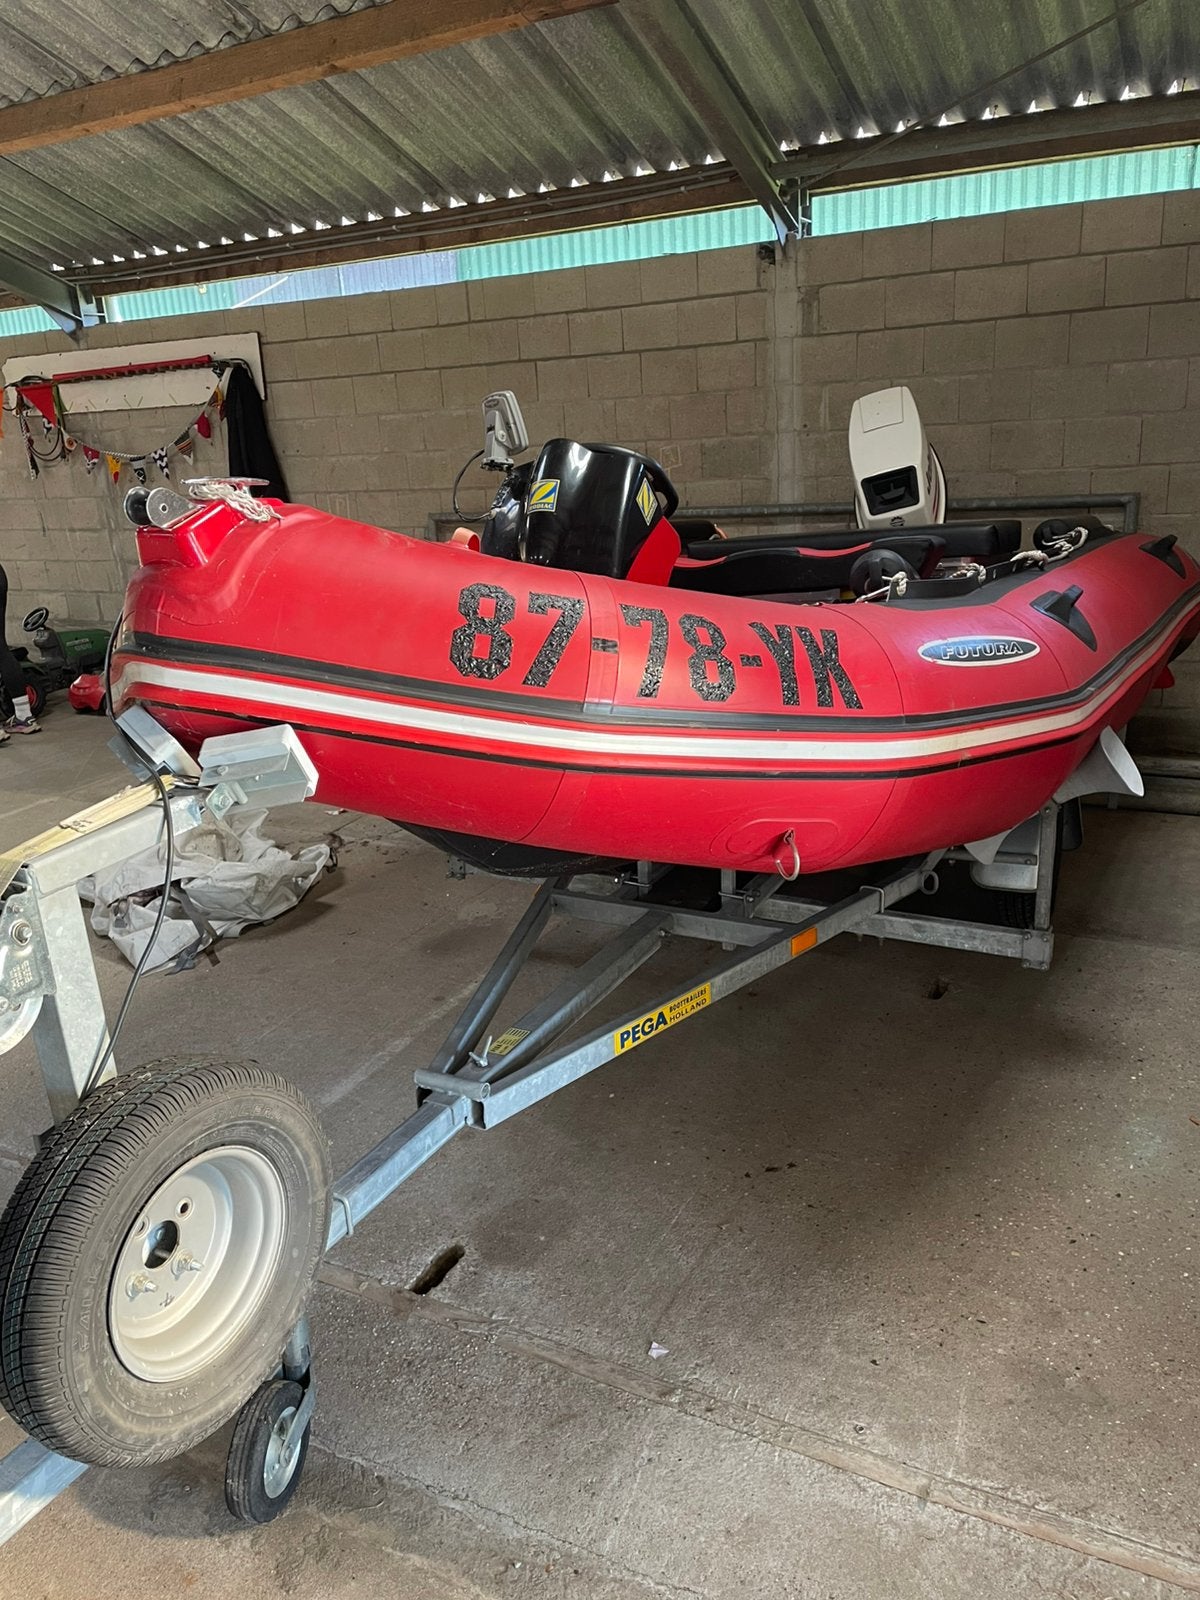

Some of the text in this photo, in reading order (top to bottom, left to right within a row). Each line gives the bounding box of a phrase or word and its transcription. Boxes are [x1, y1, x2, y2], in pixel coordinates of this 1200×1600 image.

[940, 641, 1024, 660] FUTURA
[669, 998, 706, 1022] HOLLAND
[620, 1011, 668, 1049] PEGA
